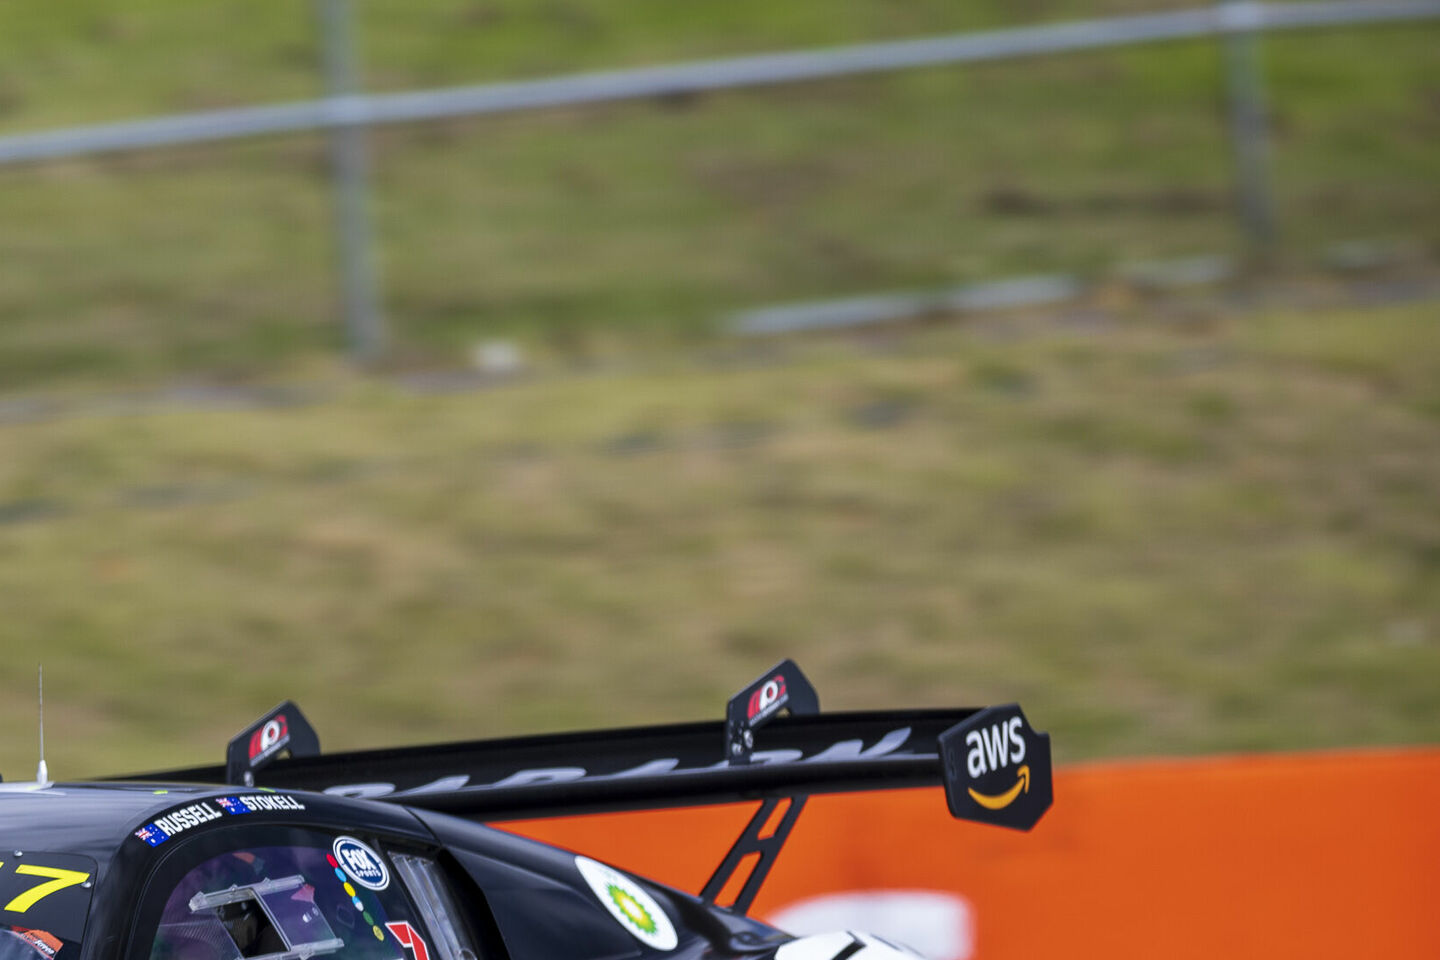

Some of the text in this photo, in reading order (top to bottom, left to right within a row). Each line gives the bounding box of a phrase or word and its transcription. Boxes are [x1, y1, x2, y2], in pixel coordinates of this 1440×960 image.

[966, 716, 1027, 778] aws
[240, 795, 306, 812] STOKELL
[155, 803, 223, 837] RUSSELL
[341, 849, 377, 870] FOX
